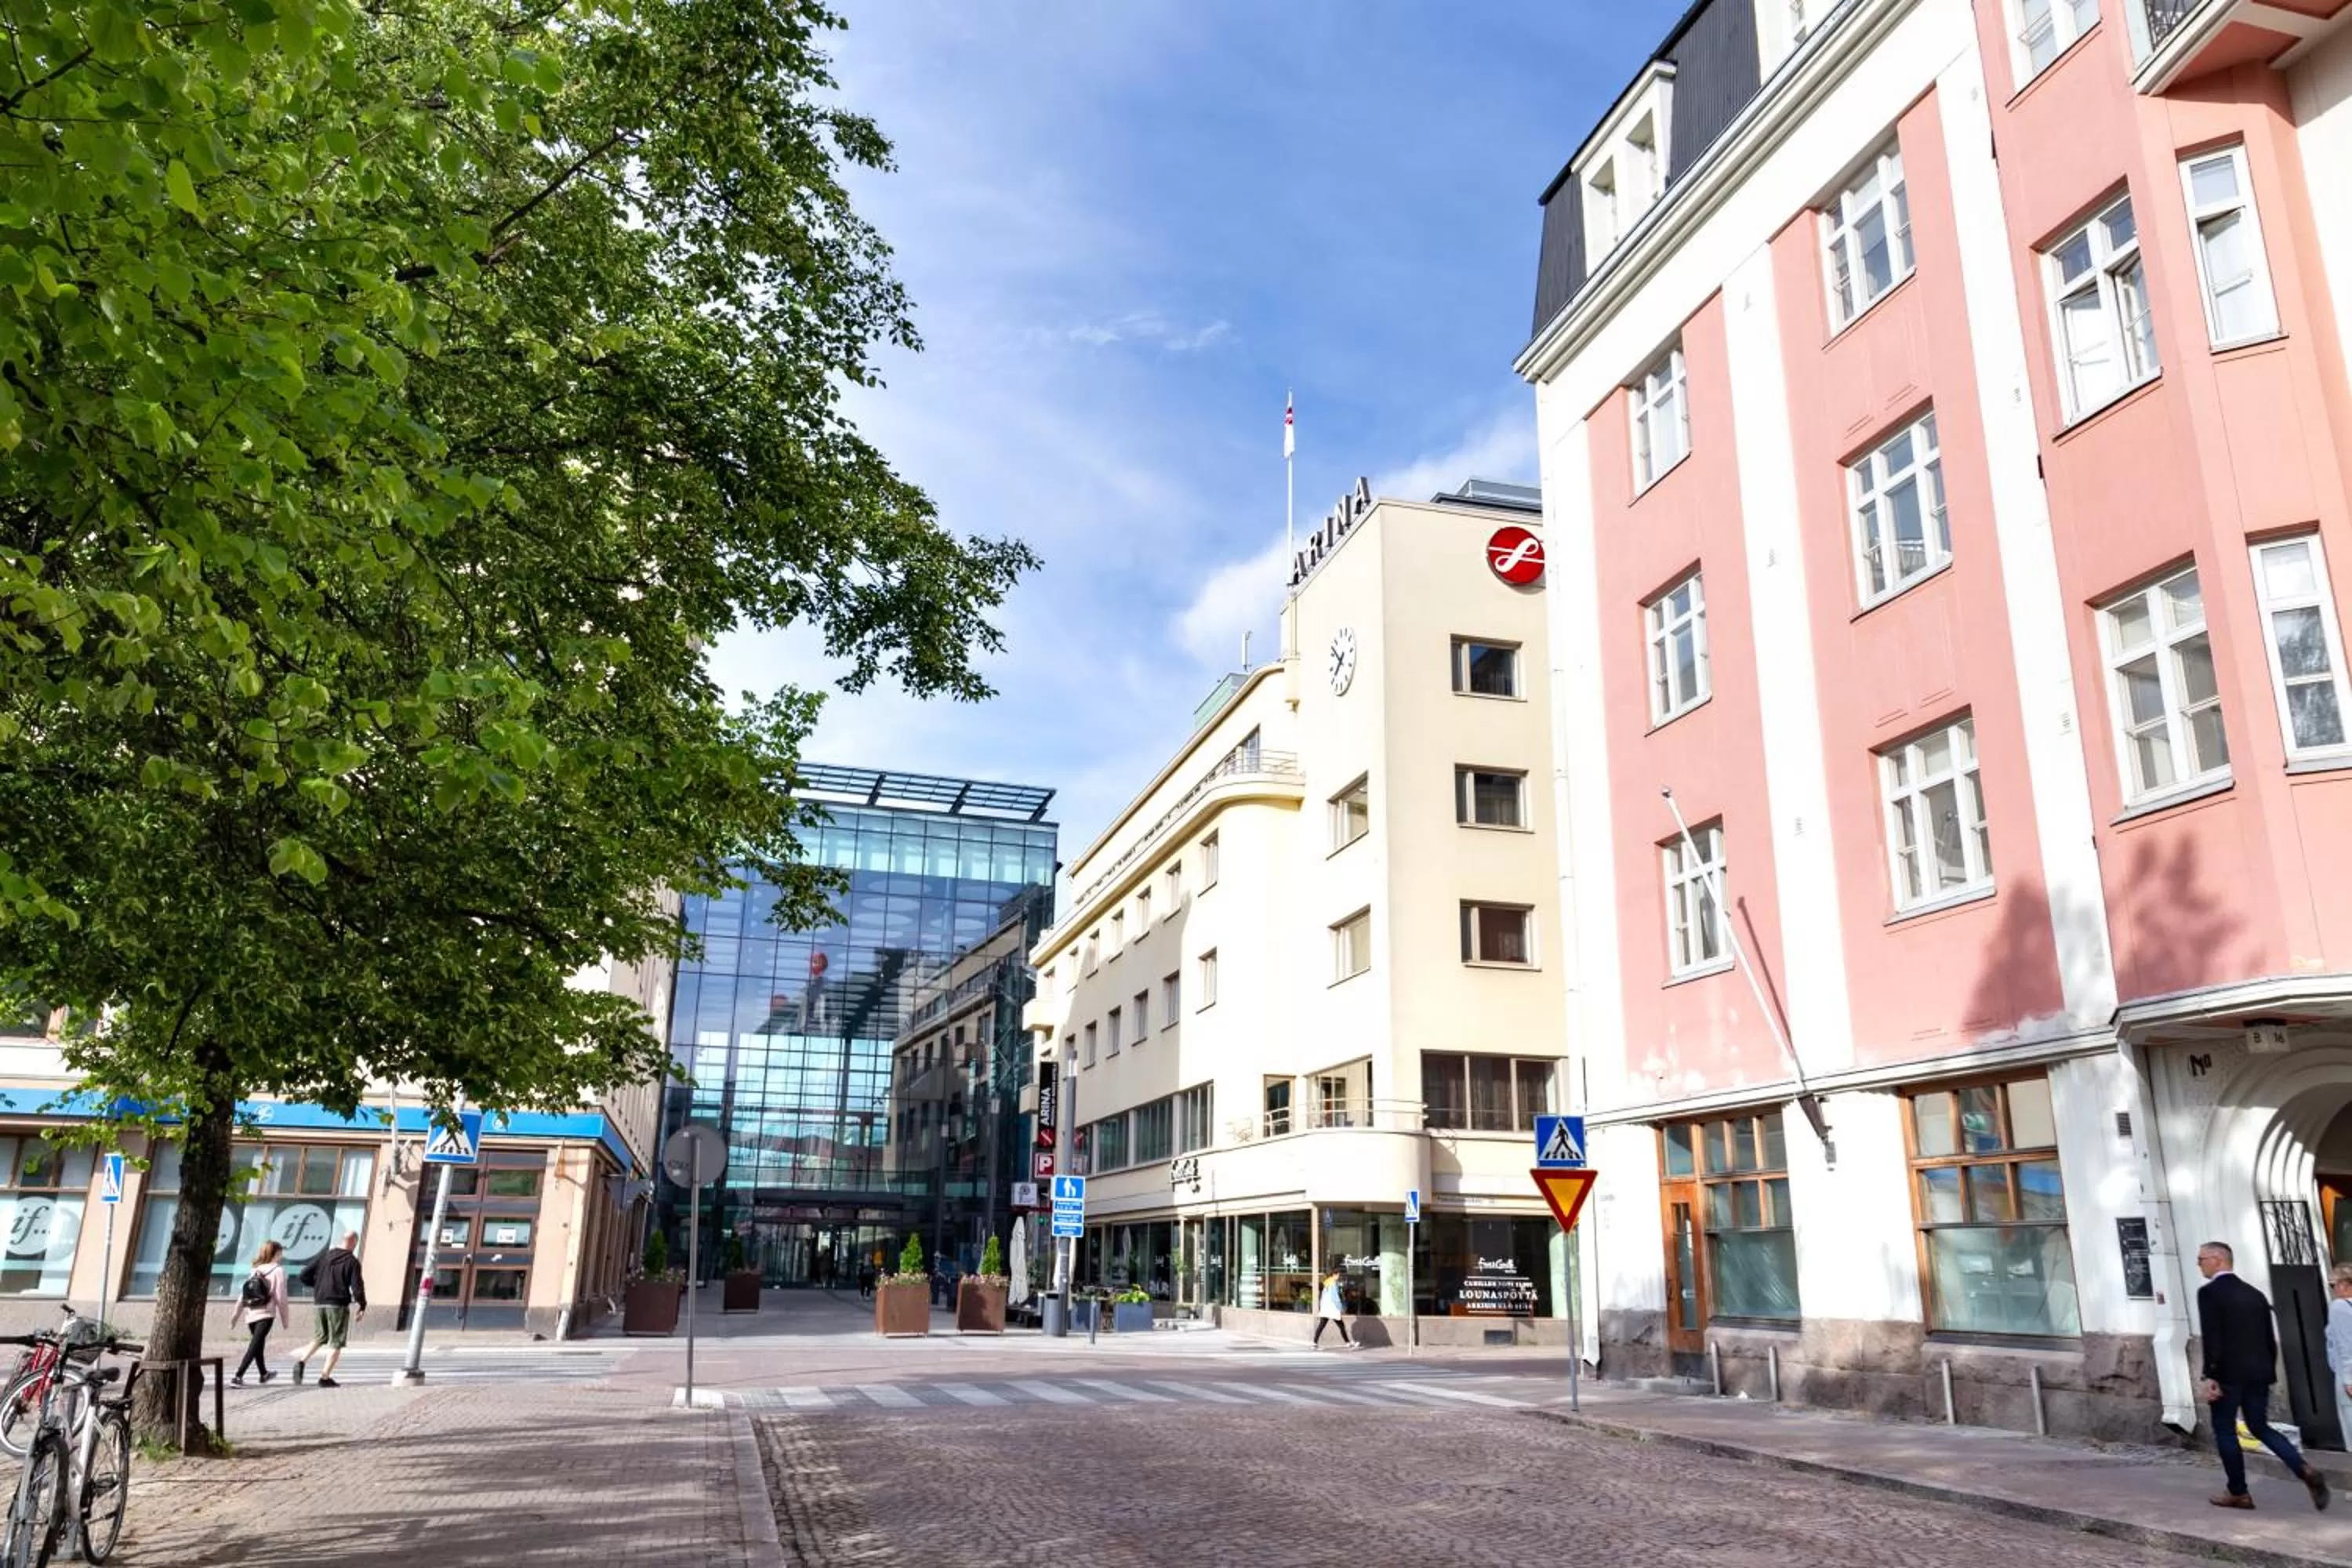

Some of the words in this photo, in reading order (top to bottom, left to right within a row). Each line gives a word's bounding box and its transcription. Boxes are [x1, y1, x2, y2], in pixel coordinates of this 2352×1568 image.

[1292, 476, 1371, 586] ARINA
[1040, 1087, 1051, 1126] ARINA
[1039, 1156, 1052, 1172] P
